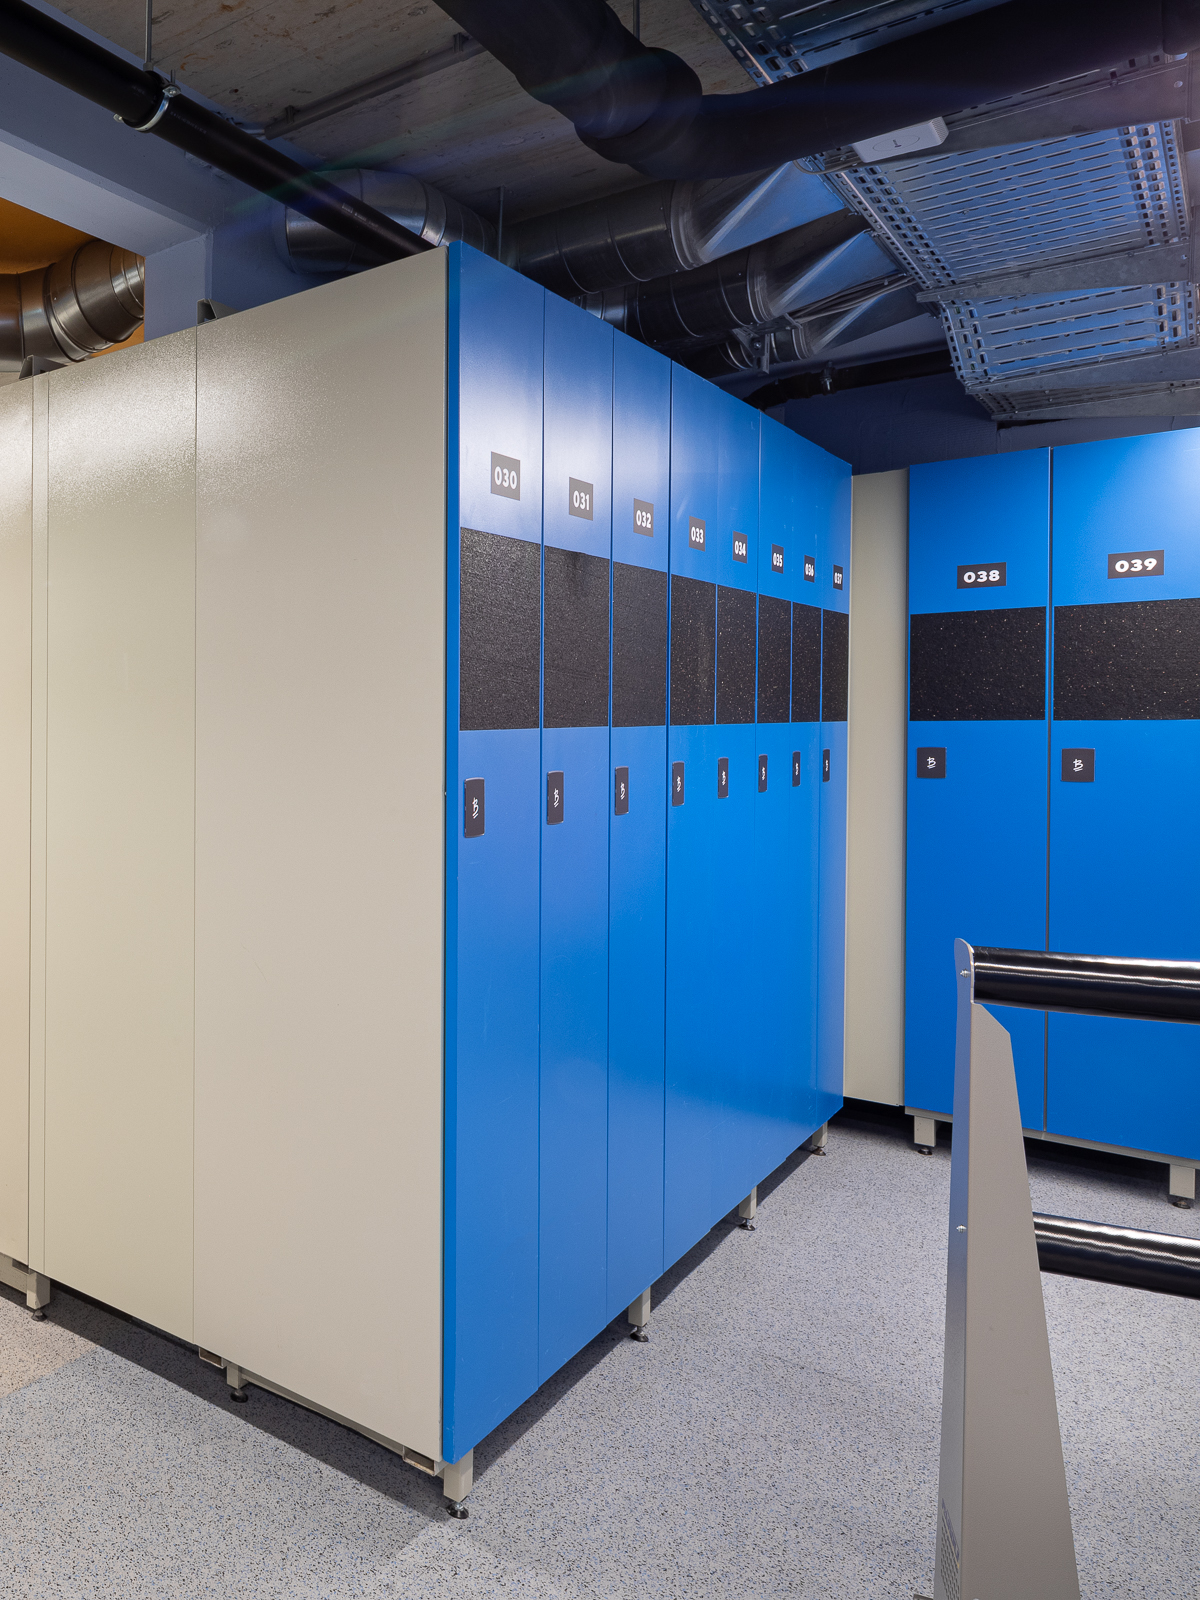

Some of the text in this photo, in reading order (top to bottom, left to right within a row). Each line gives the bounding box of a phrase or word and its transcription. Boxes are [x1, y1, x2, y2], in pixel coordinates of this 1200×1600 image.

[494, 466, 518, 490] 030
[573, 490, 590, 511] 031
[635, 509, 652, 529] 032
[690, 526, 704, 544] 033
[734, 540, 747, 557] 034
[772, 552, 783, 568] 035
[1114, 557, 1158, 573] 039
[805, 563, 814, 577] 036
[963, 569, 1000, 584] 038
